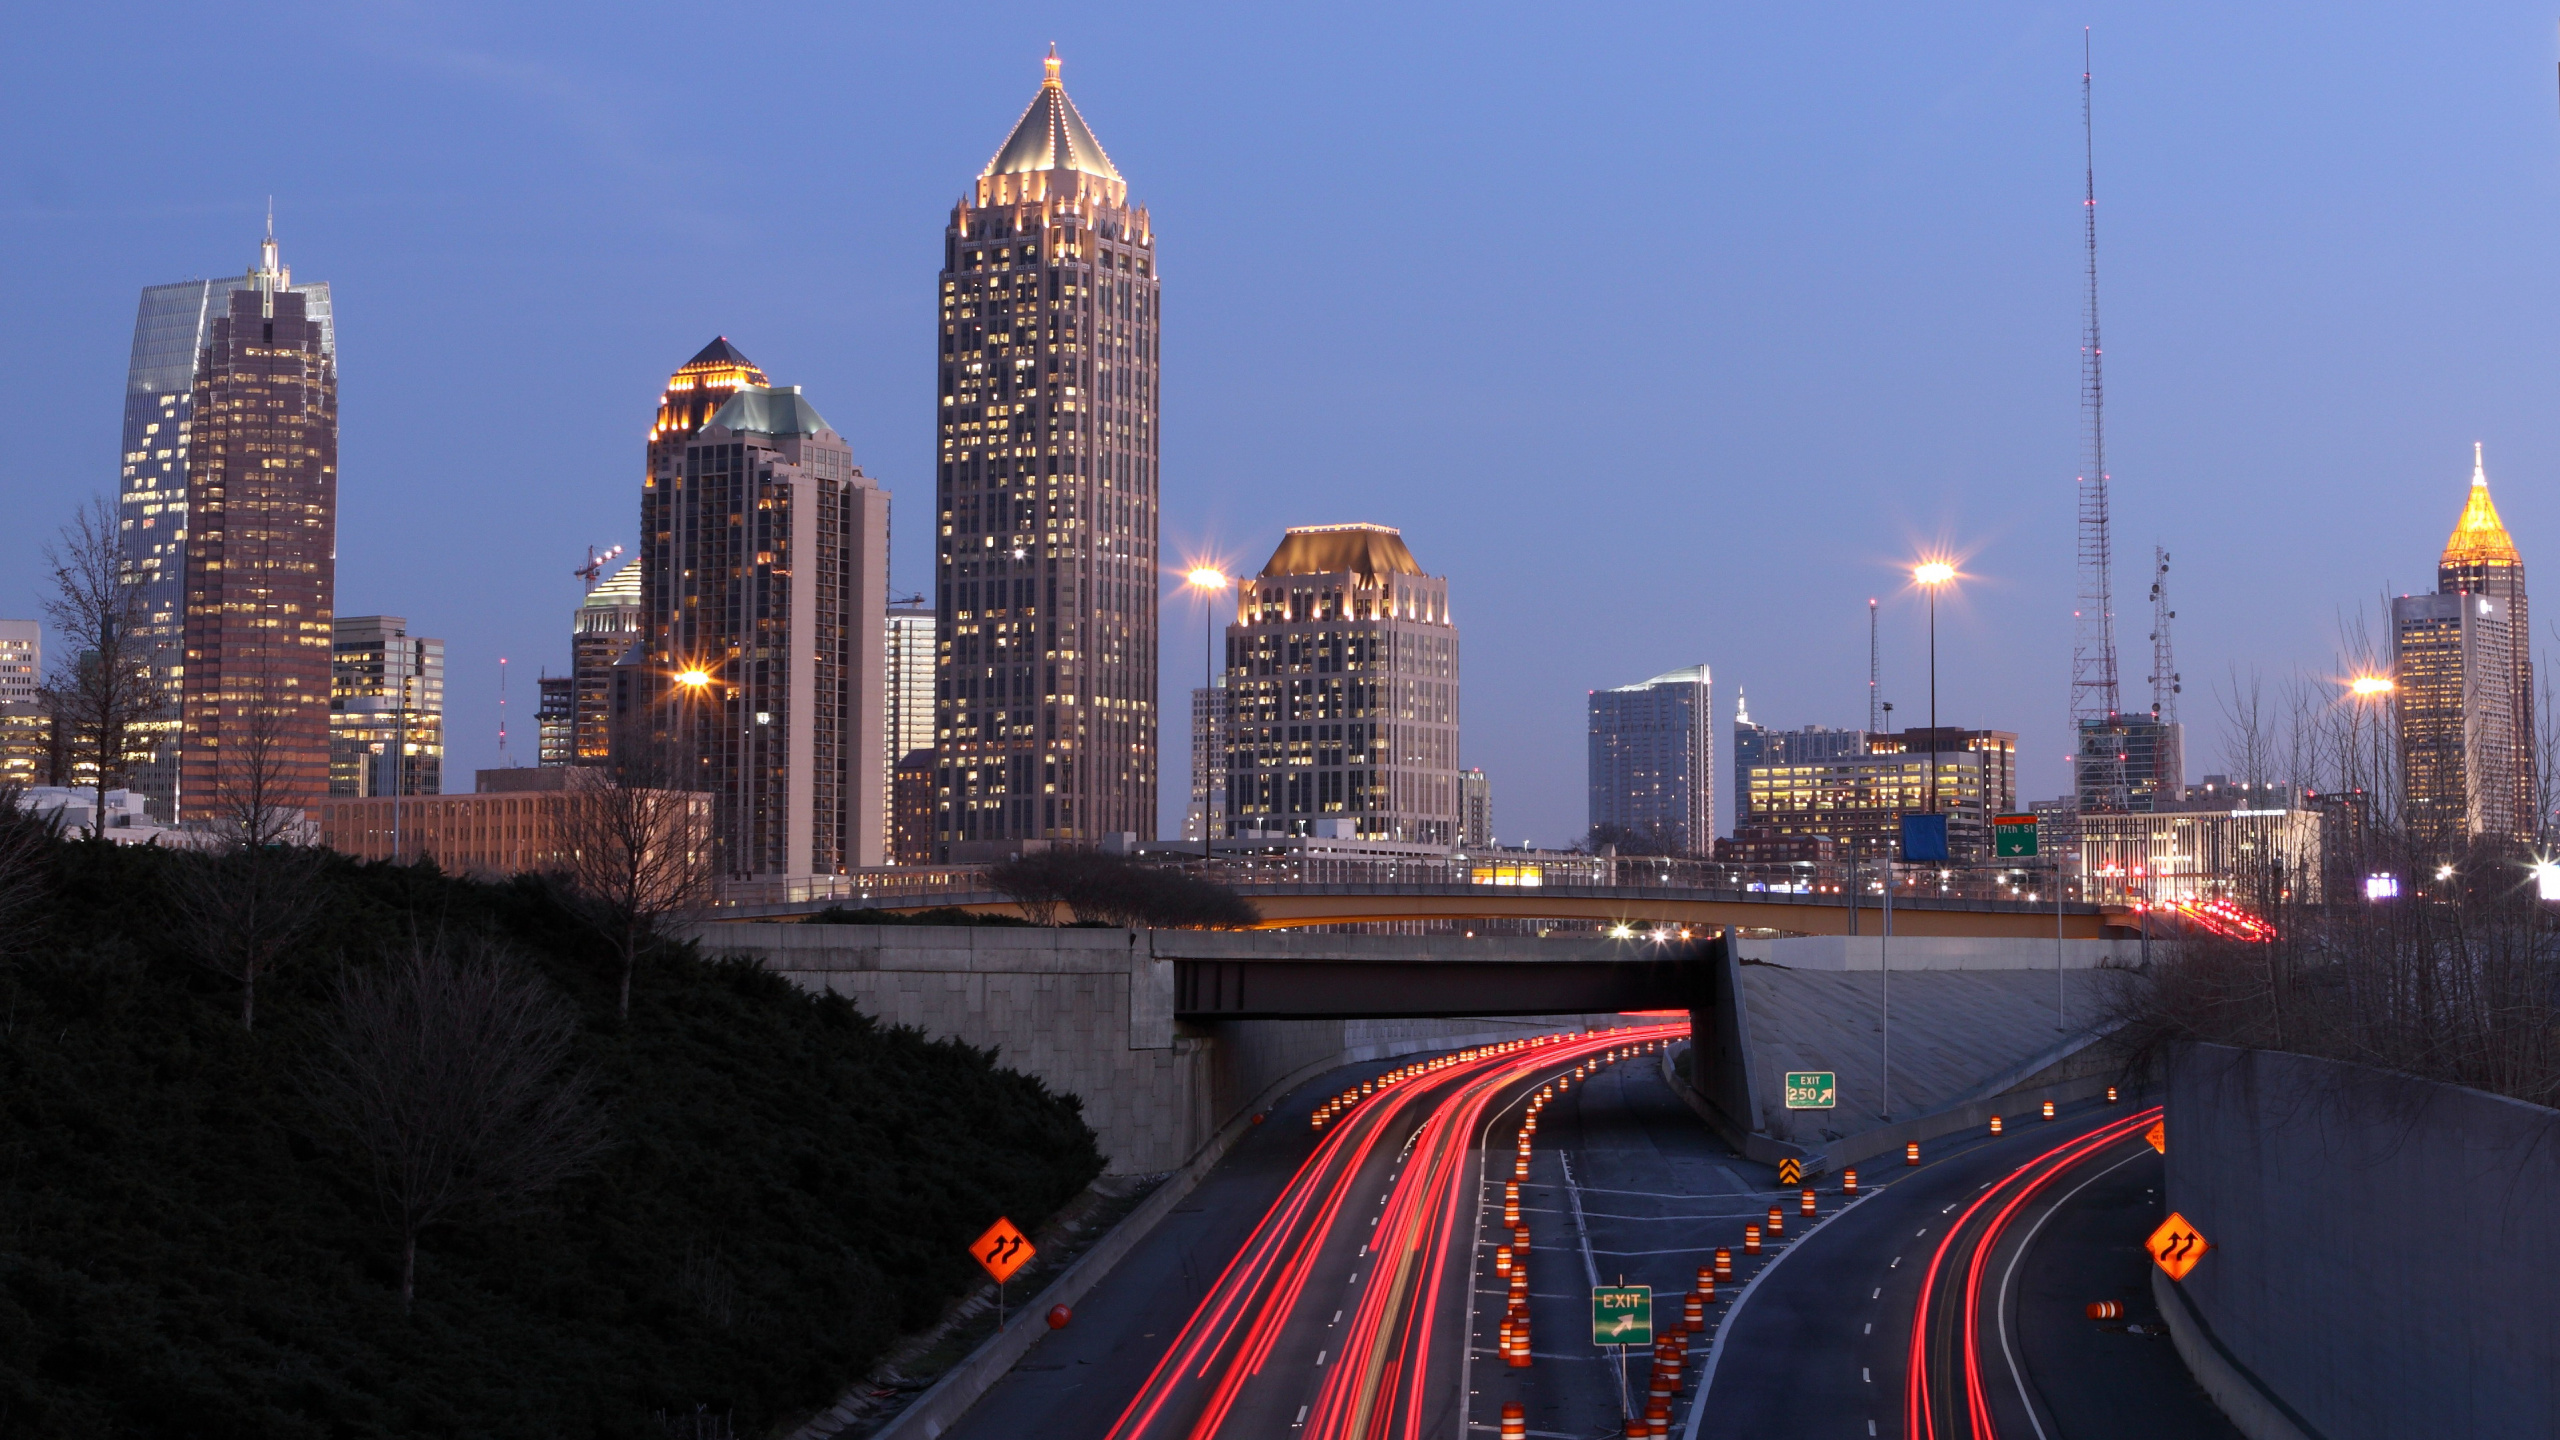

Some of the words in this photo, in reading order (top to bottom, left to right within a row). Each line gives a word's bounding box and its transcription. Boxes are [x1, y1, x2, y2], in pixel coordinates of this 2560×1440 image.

[1998, 825, 2018, 834] 17th
[2023, 824, 2034, 833] St
[1800, 1076, 1820, 1085] EXIT
[1789, 1088, 1817, 1101] 250
[1603, 1294, 1641, 1308] EXIT
